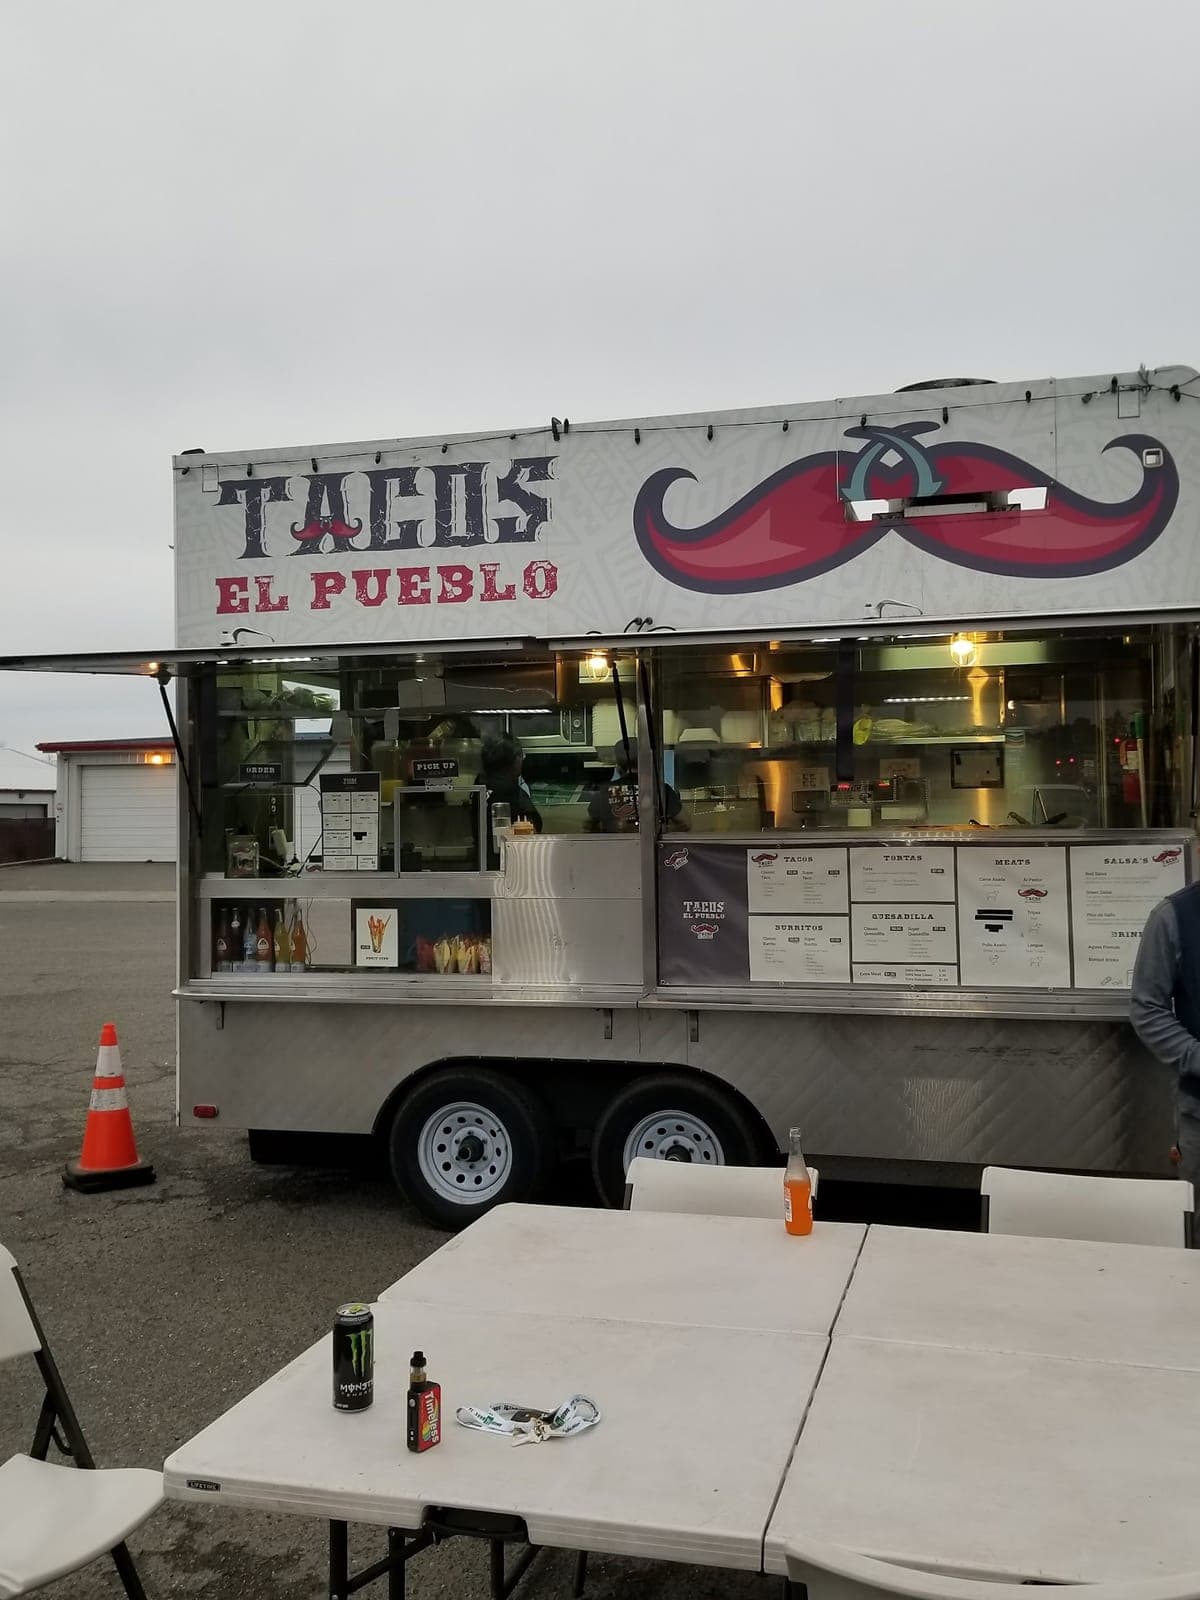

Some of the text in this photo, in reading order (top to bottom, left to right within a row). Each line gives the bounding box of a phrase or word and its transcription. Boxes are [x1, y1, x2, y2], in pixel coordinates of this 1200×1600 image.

[213, 455, 560, 559] TACOS
[215, 560, 559, 614] EL PUEBLO
[416, 763, 440, 771] PICK
[1104, 857, 1149, 865] SALSA'S
[683, 901, 725, 912] TACOS
